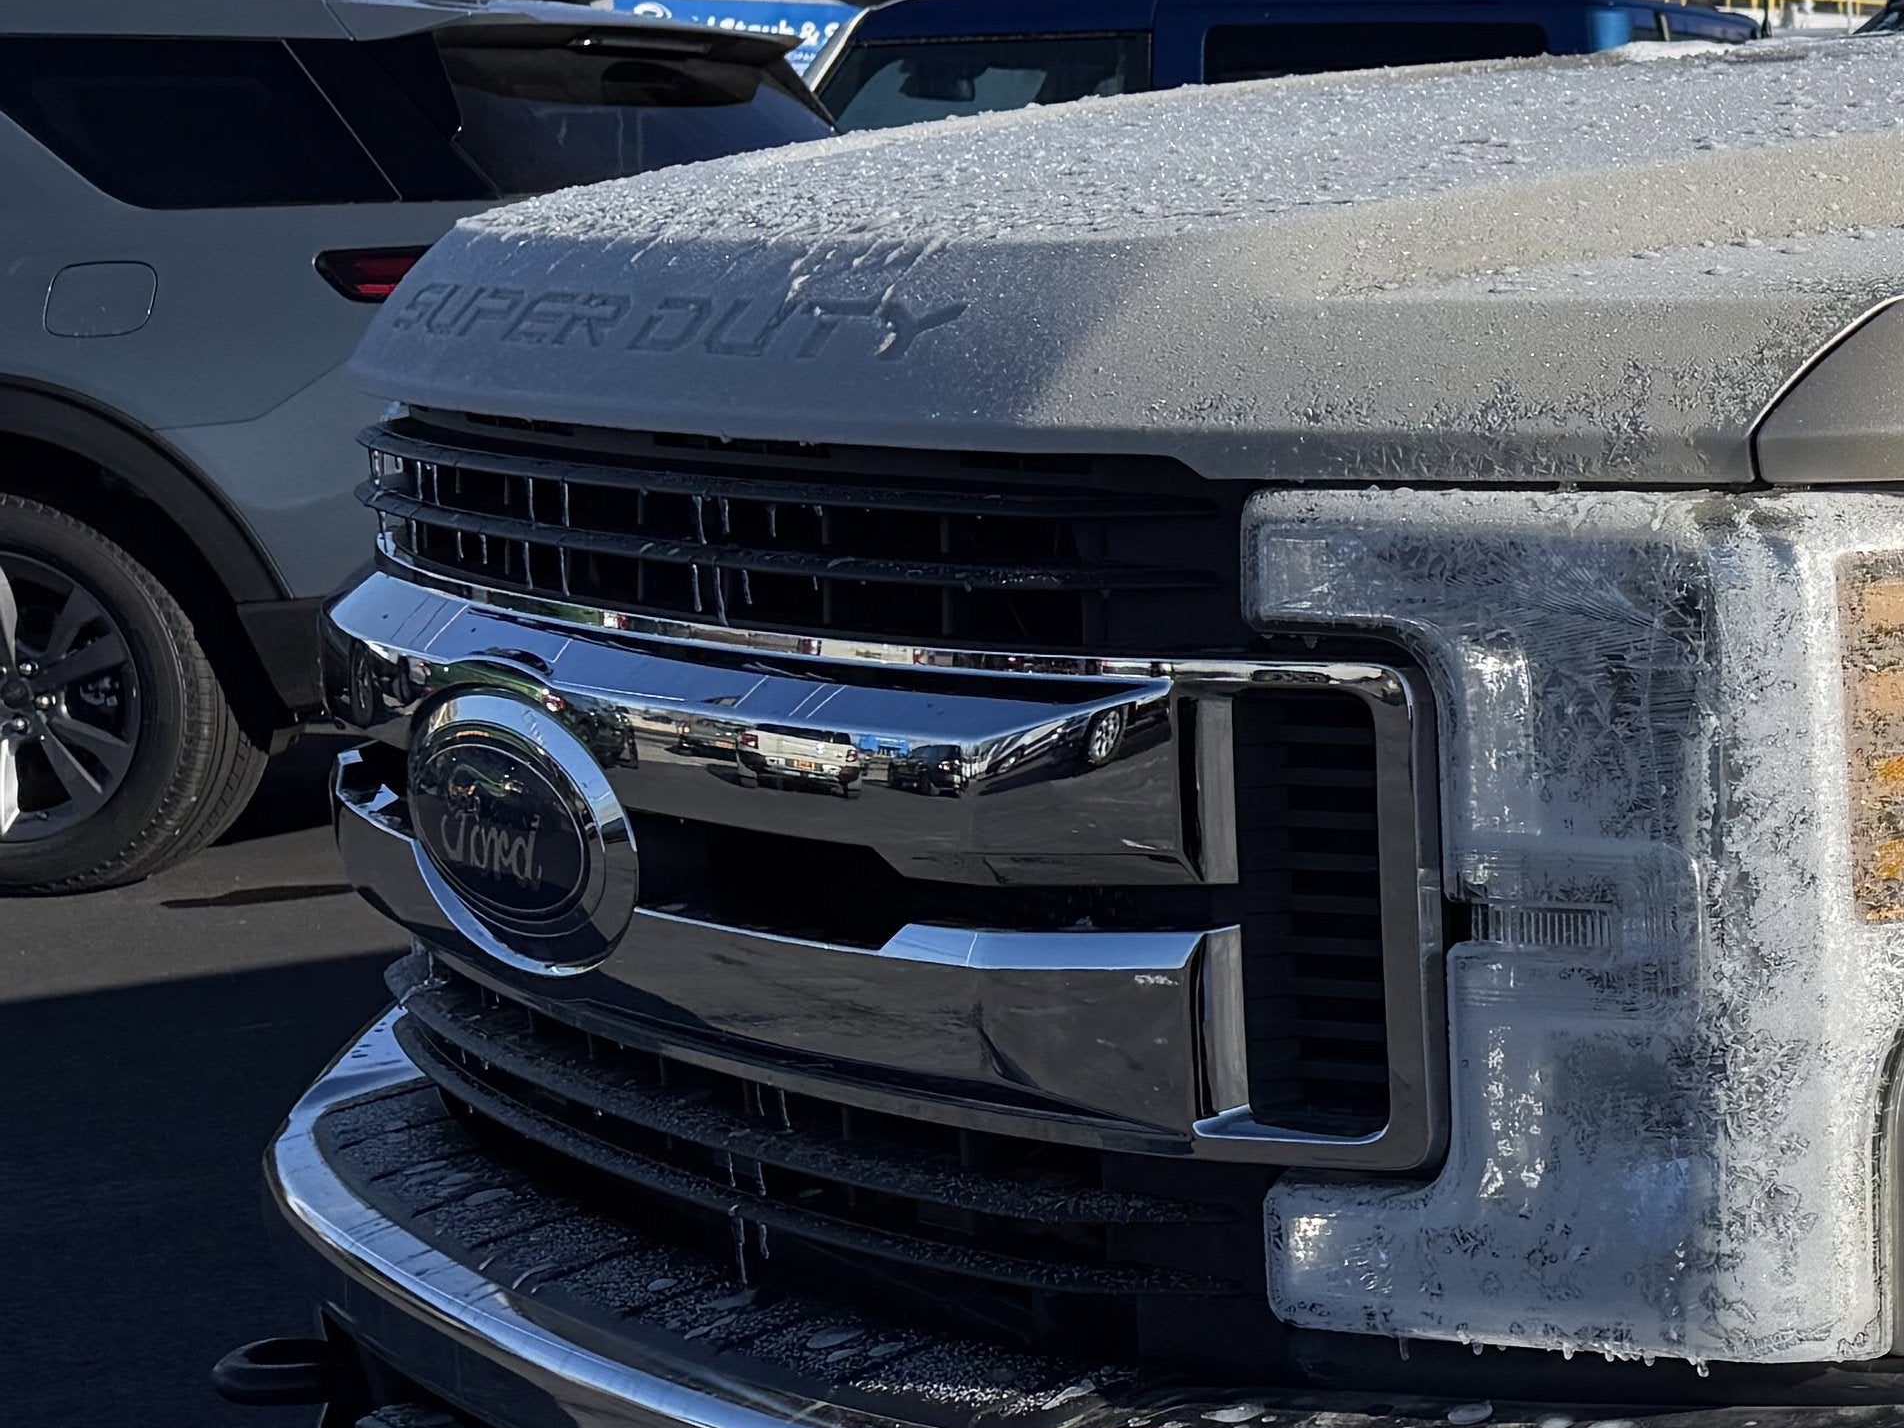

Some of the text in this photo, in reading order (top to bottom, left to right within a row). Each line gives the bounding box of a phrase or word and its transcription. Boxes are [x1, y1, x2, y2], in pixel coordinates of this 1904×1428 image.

[394, 281, 970, 361] SUPER DUTY
[441, 796, 543, 891] Ford
